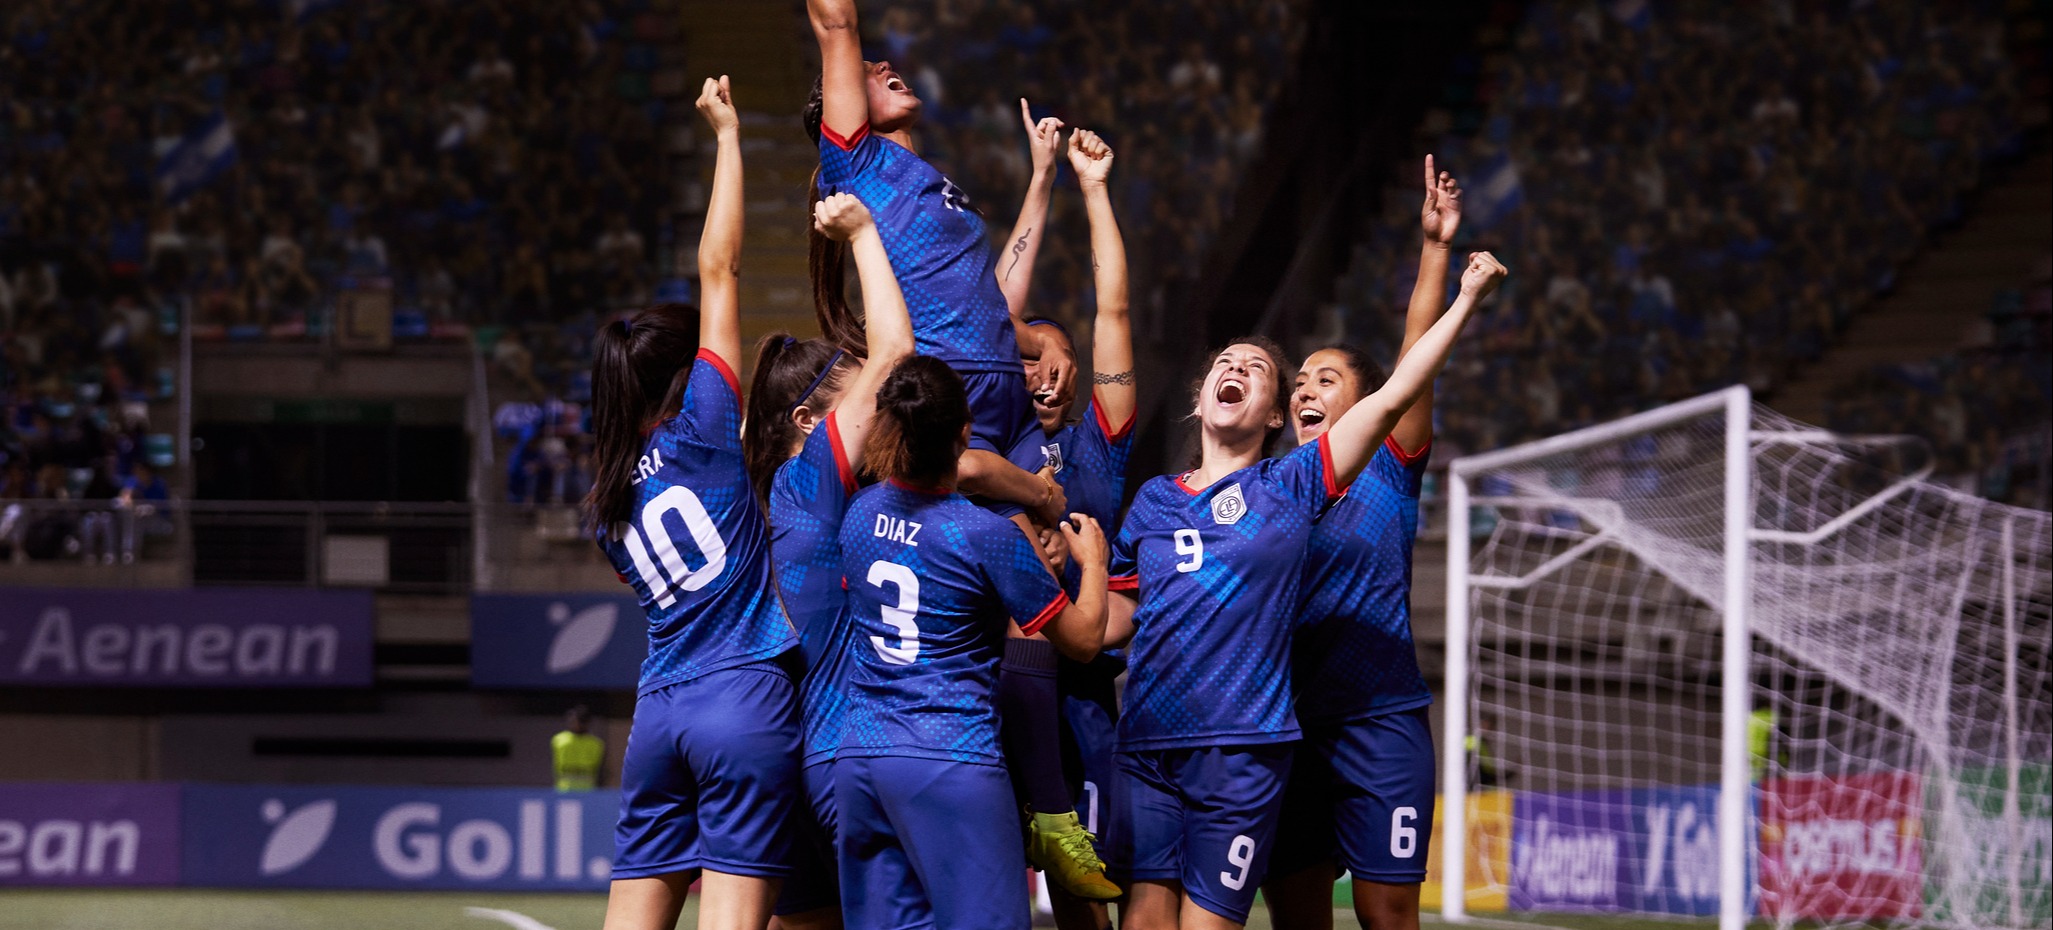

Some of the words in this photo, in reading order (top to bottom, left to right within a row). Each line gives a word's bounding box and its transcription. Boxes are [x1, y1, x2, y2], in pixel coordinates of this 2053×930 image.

[613, 485, 727, 610] 10
[873, 513, 923, 547] DIAZ
[1174, 529, 1204, 573] 9
[21, 606, 340, 676] Aenean
[866, 559, 921, 666] 3
[373, 799, 612, 881] Goll.
[1220, 834, 1256, 892] 9
[1390, 806, 1418, 859] 6
